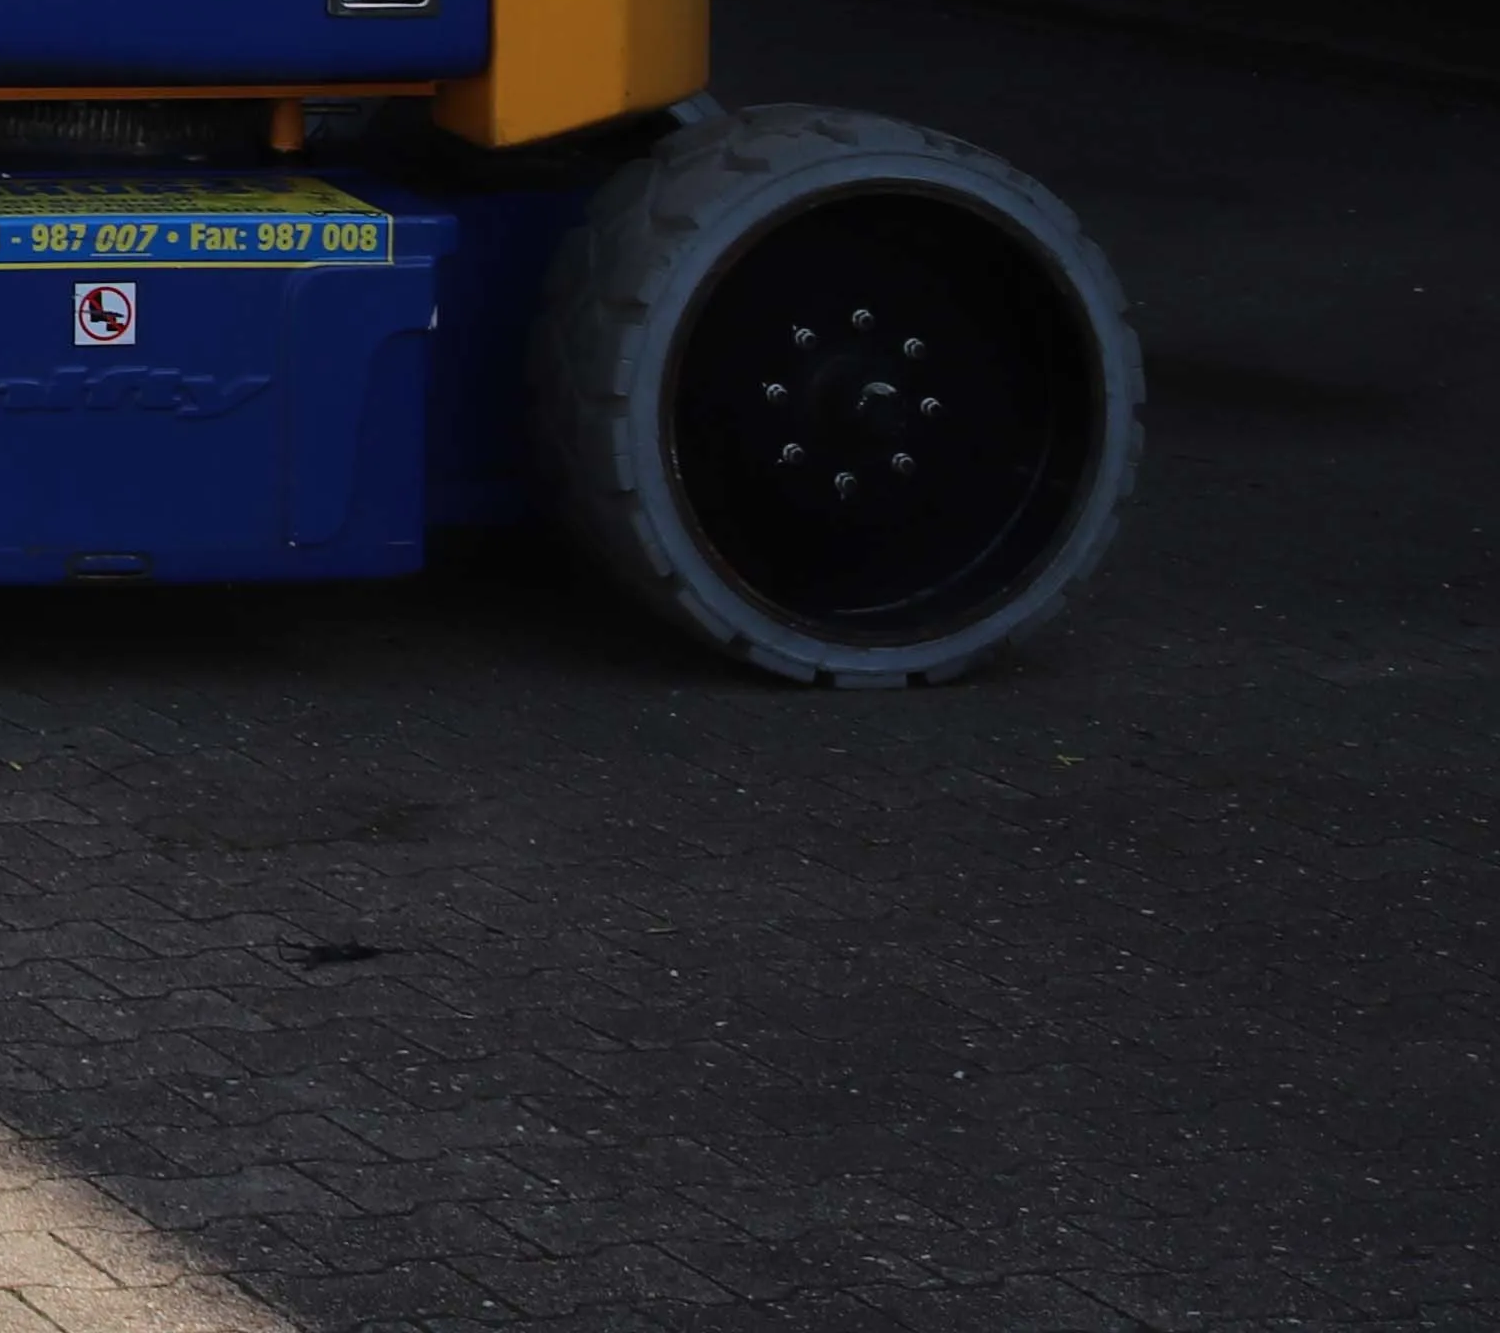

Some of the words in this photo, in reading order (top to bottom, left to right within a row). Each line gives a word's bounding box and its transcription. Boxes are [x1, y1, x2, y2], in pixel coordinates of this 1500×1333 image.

[31, 223, 88, 252] 987
[94, 224, 159, 253] 007
[190, 223, 247, 251] Fax:
[257, 223, 312, 251] 987
[322, 223, 378, 251] 008
